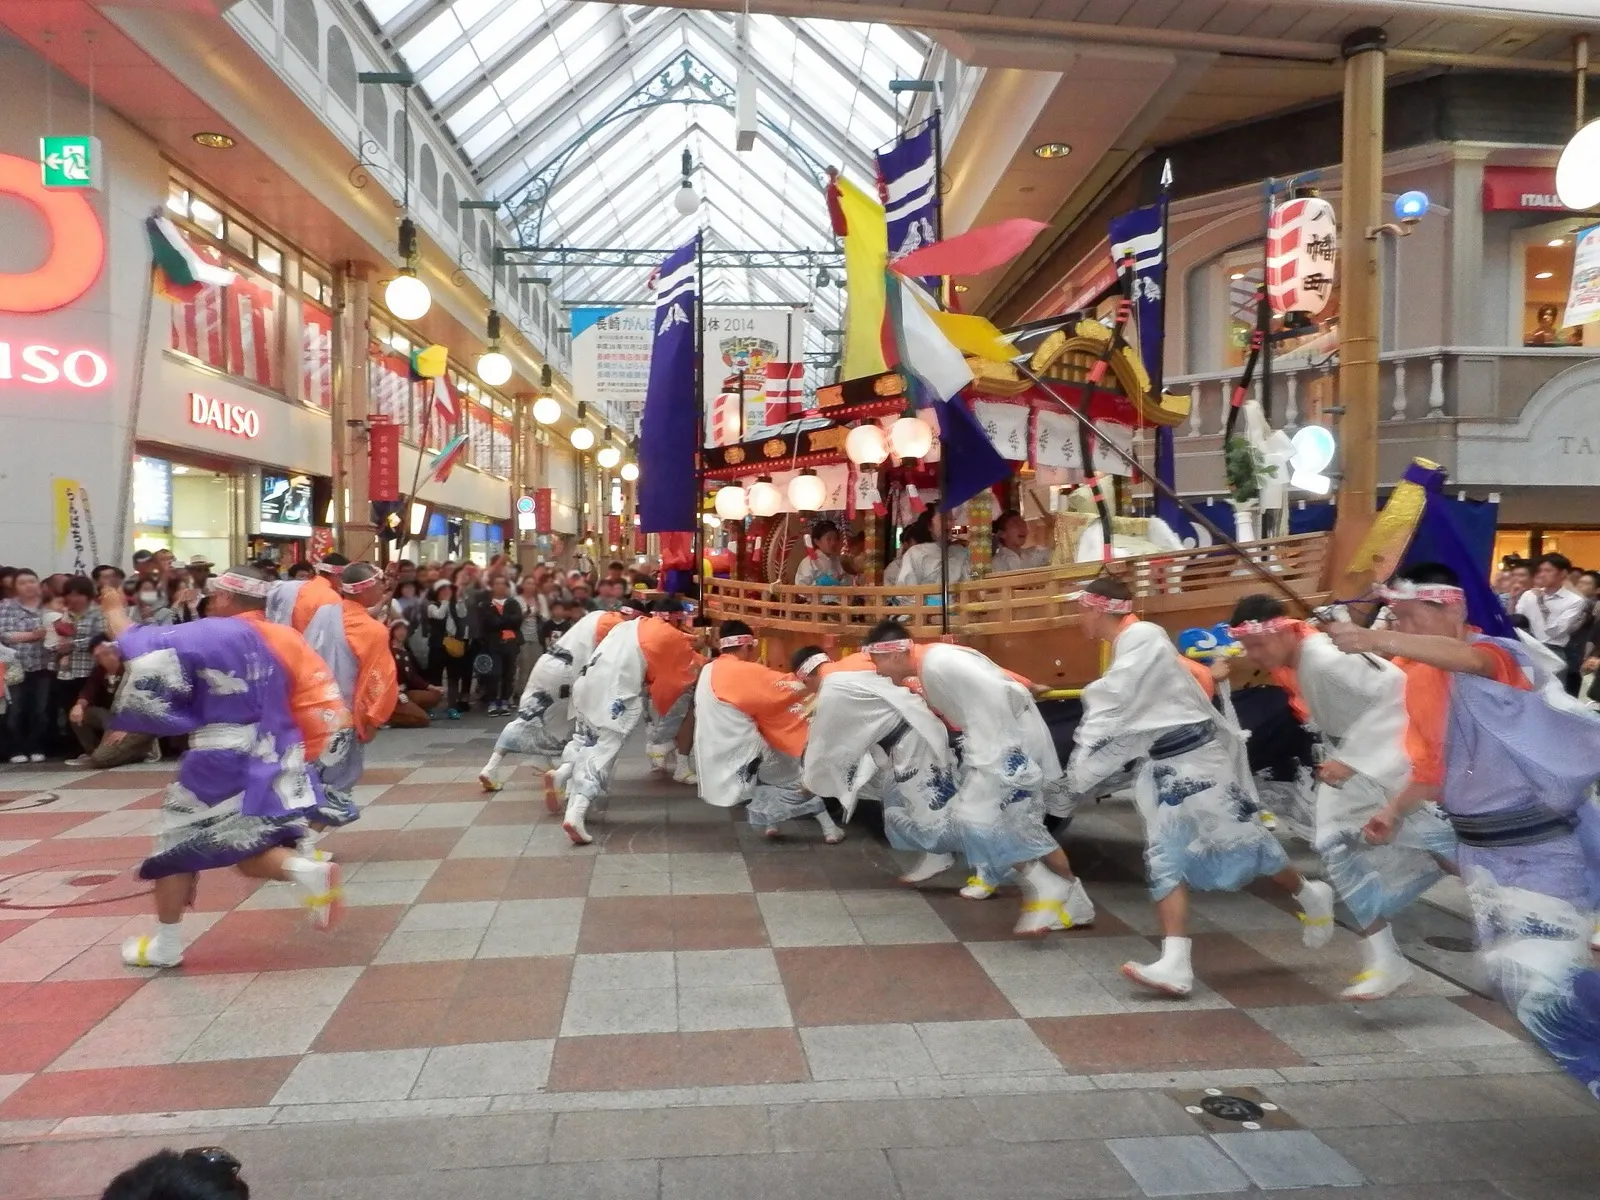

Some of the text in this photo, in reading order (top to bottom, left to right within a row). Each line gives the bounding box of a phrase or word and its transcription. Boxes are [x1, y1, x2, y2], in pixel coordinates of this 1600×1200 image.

[724, 318, 755, 331] 2014
[188, 392, 260, 438] DAISO
[1557, 435, 1600, 455] TA
